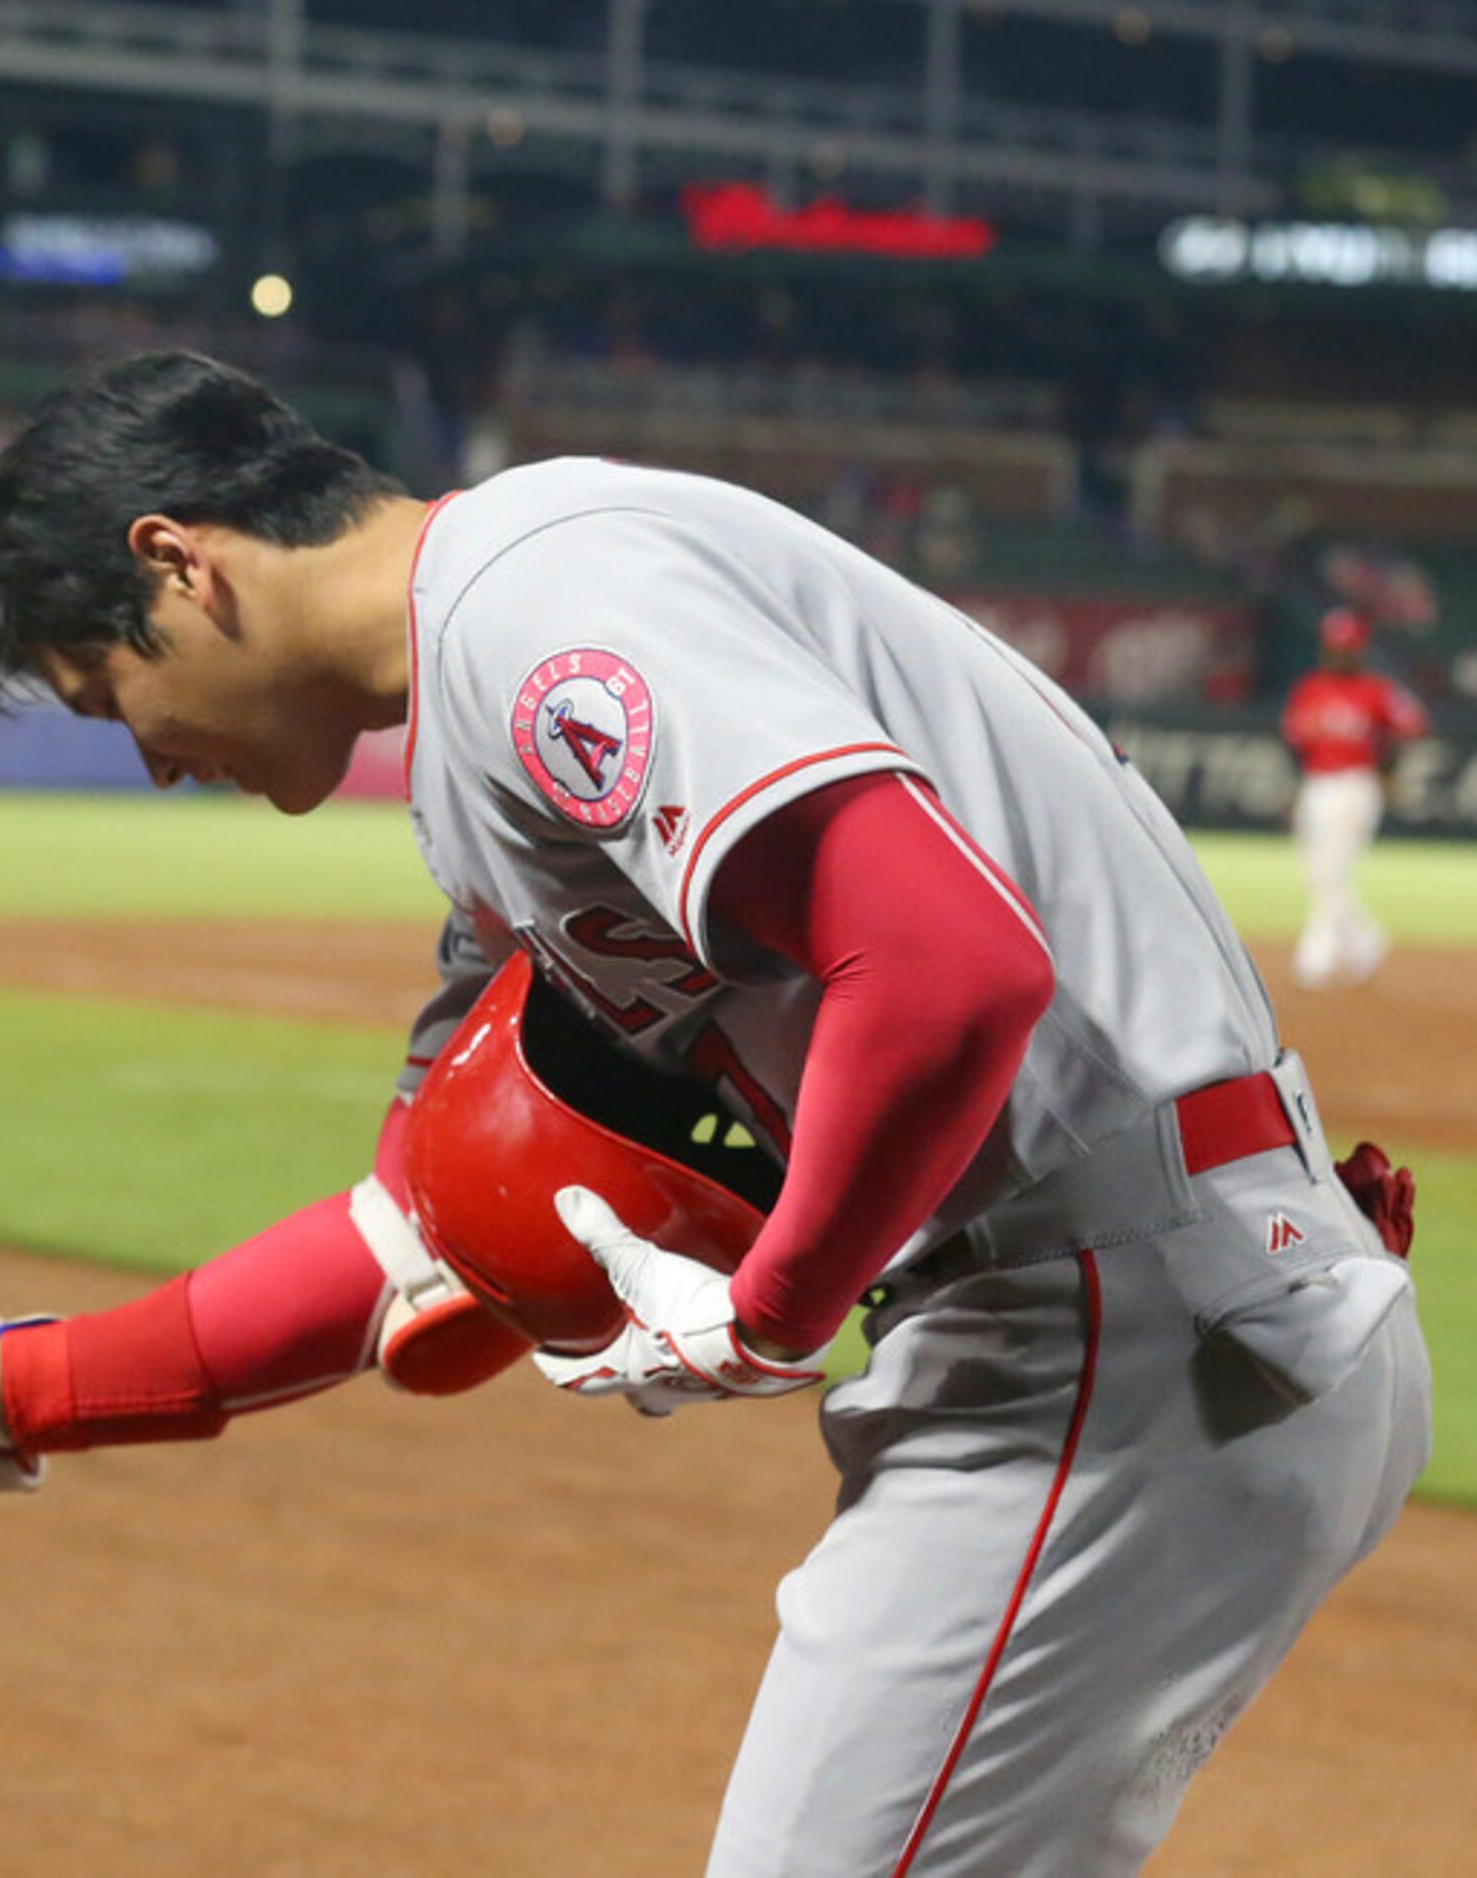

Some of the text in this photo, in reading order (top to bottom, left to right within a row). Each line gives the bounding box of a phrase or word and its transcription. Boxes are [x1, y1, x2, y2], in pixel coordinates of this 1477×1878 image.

[516, 654, 581, 754] ANGELS
[605, 667, 637, 695] 61
[545, 698, 623, 791] A
